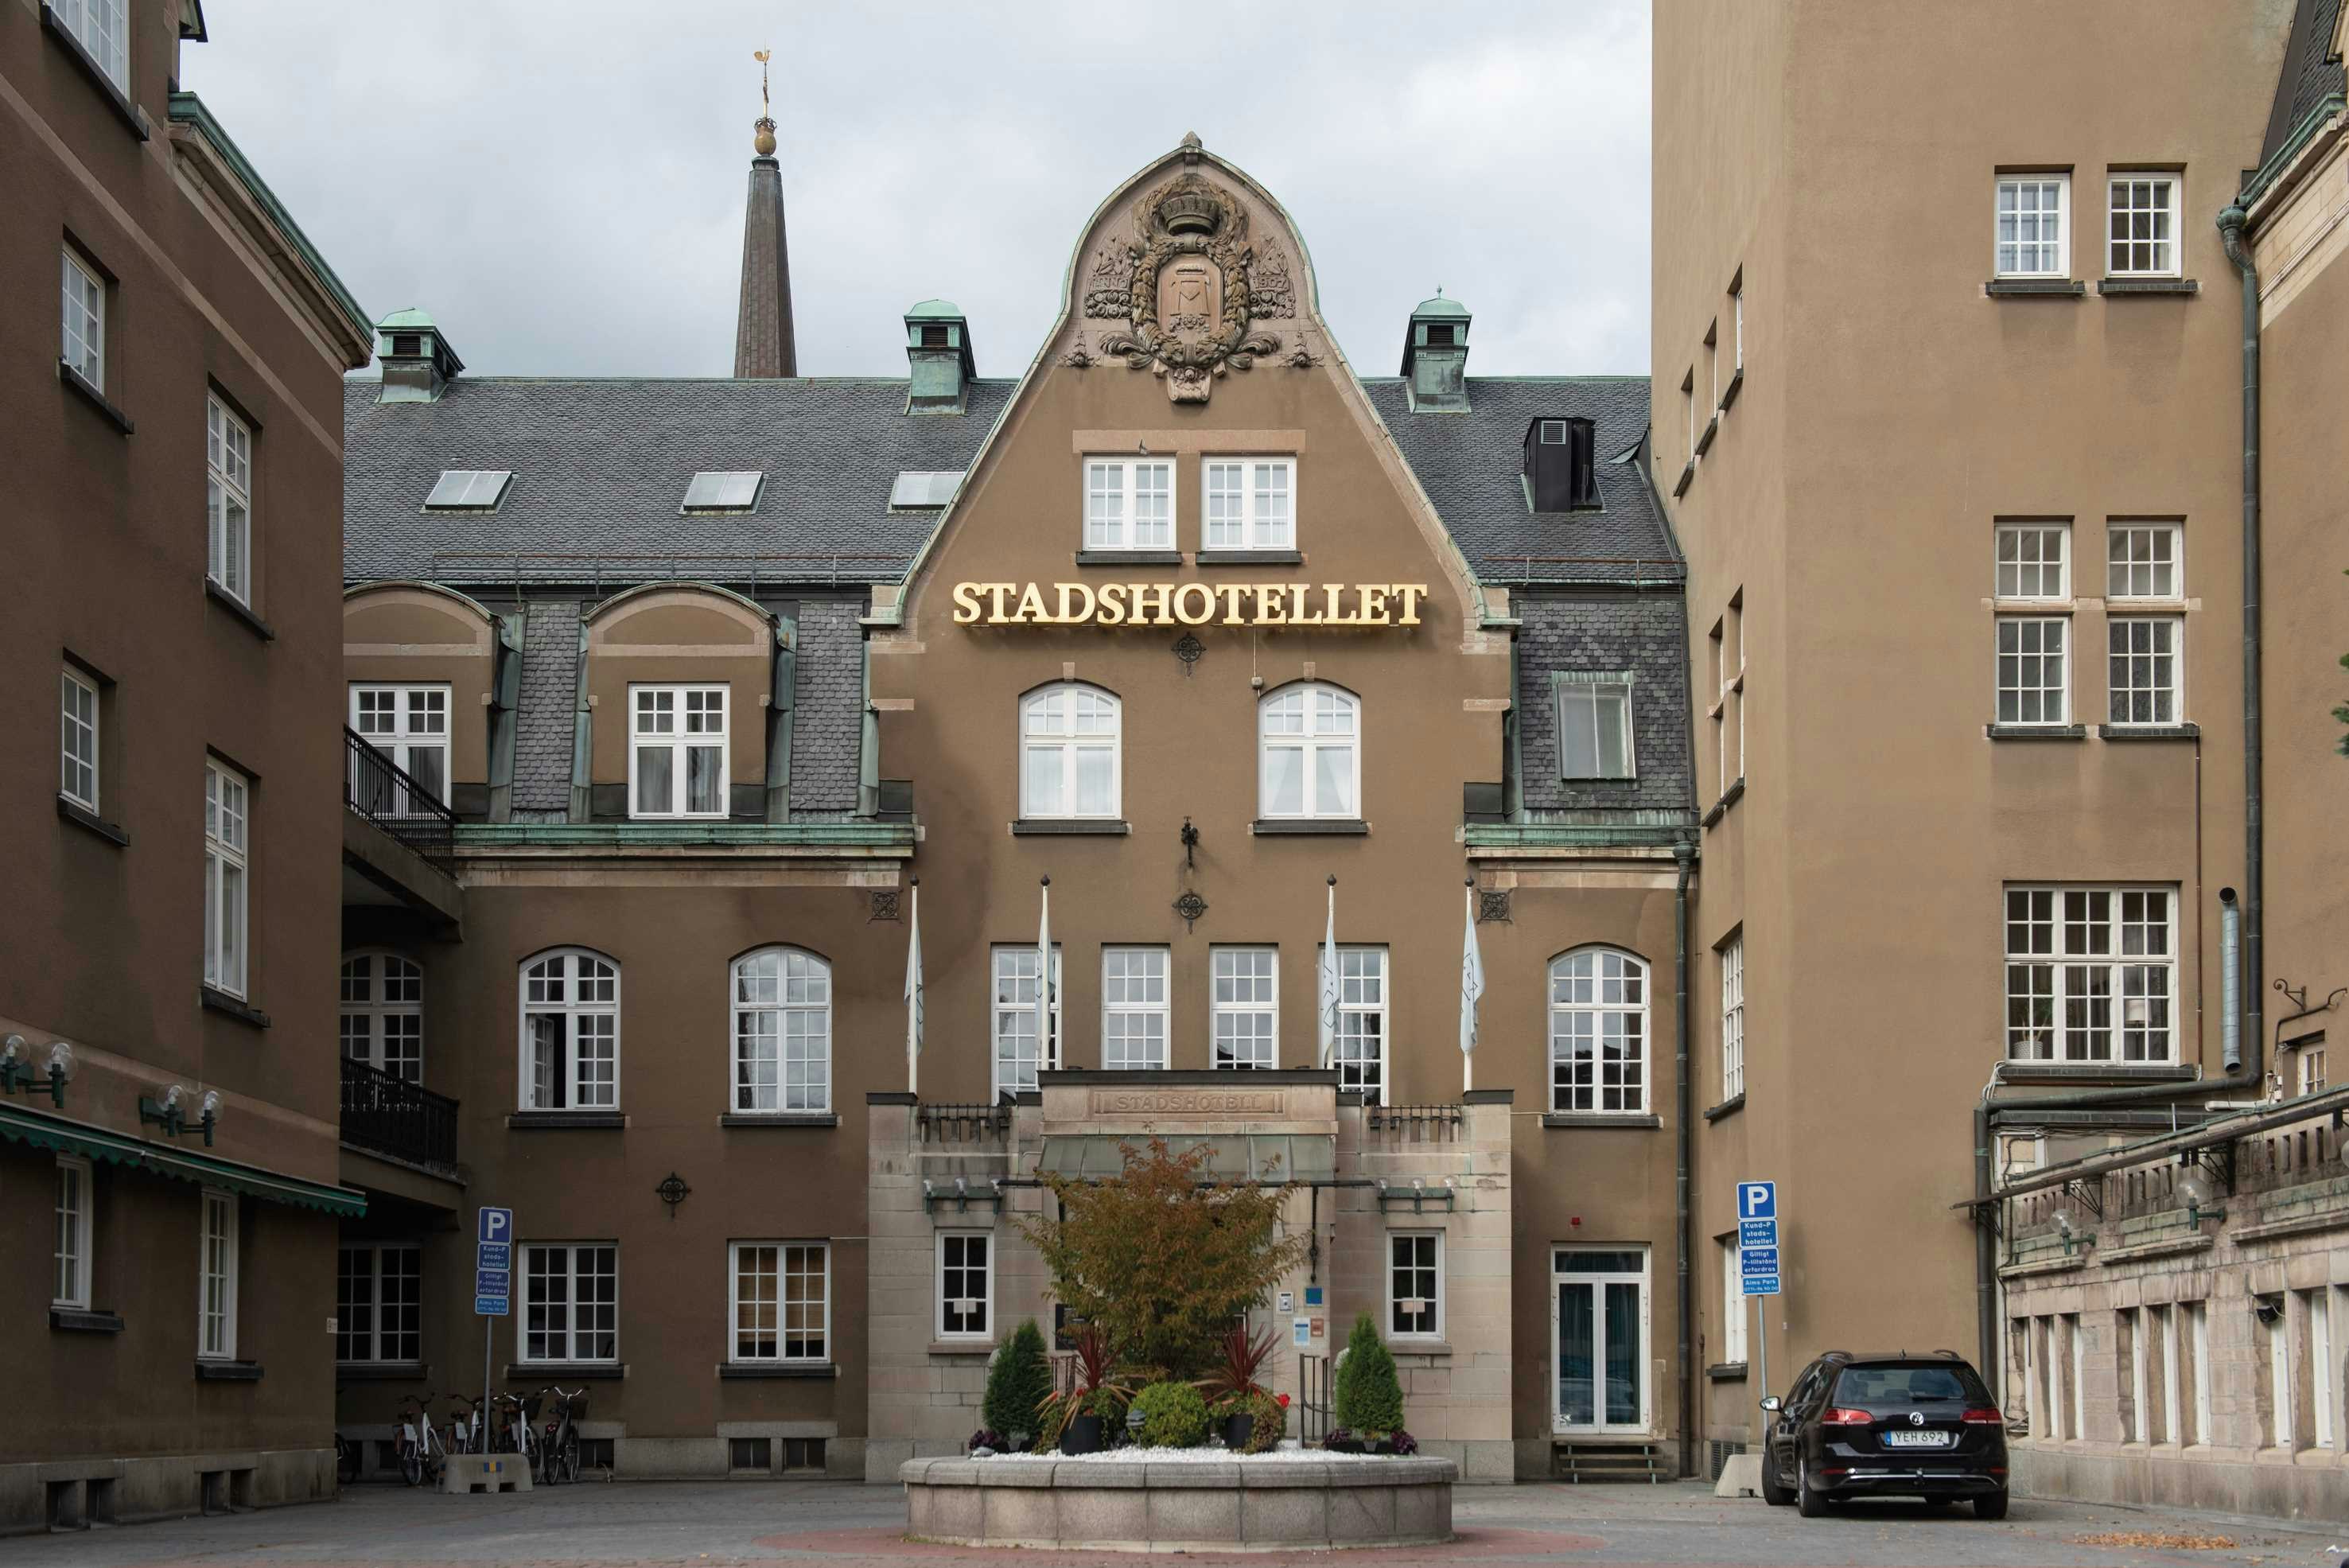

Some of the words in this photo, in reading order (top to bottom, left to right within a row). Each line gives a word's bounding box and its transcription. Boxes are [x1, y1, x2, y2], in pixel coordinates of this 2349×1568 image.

[1092, 278, 1129, 290] ANNO
[1253, 278, 1287, 289] 1907
[953, 582, 1428, 625] STADSHOTELLET
[1117, 1095, 1262, 1111] STADSHOTELL
[1747, 1186, 1768, 1216] P
[488, 1212, 506, 1239] P
[1895, 1431, 1917, 1442] YEH
[1922, 1431, 1943, 1442] 692
